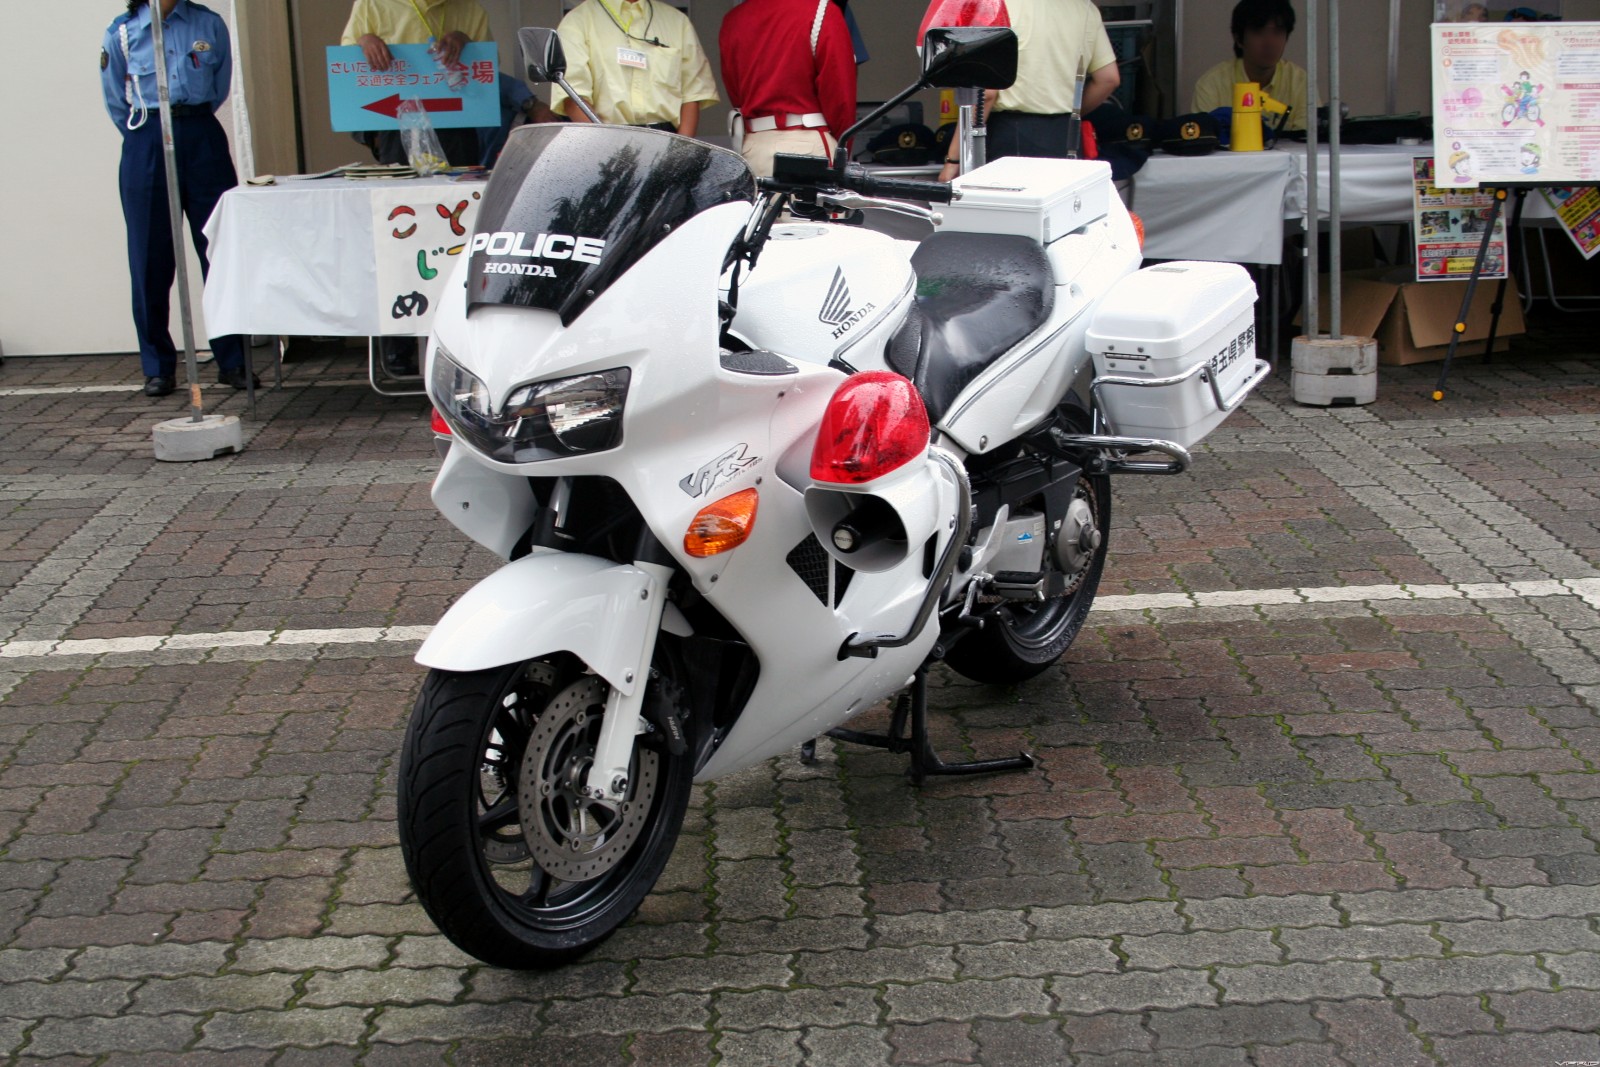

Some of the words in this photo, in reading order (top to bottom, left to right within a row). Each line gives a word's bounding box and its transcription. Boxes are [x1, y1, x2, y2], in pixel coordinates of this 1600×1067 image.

[357, 73, 445, 87] 交通安全フェア
[470, 231, 606, 266] POLICE
[483, 262, 557, 278] HONDA
[831, 302, 877, 340] HONDA
[679, 443, 758, 498] VFR
